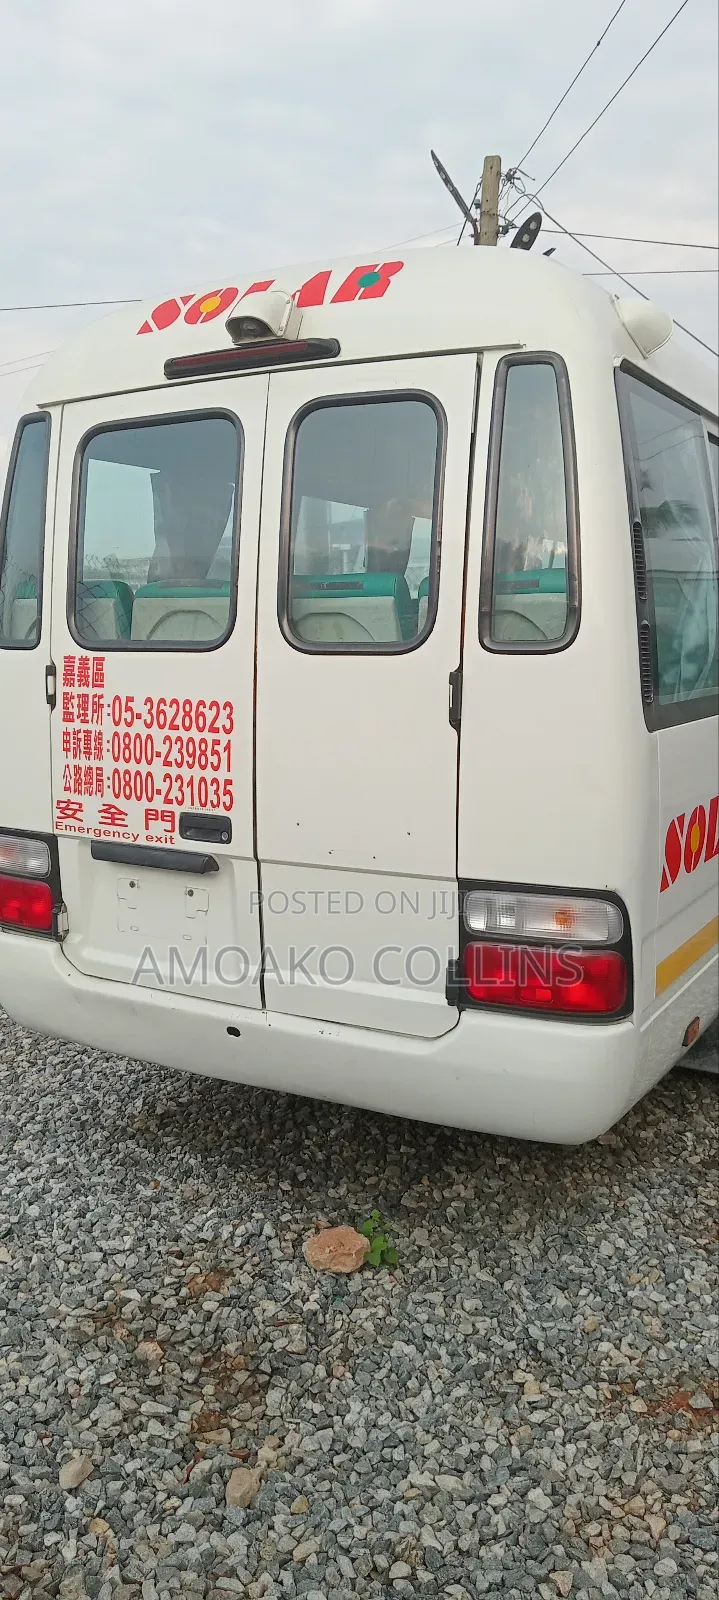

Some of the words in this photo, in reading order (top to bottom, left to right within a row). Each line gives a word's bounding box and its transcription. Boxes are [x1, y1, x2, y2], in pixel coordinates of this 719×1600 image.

[62, 655, 106, 689] 嘉義區
[55, 799, 176, 834] 安全門
[55, 821, 140, 842] Emergency
[145, 835, 176, 845] exit
